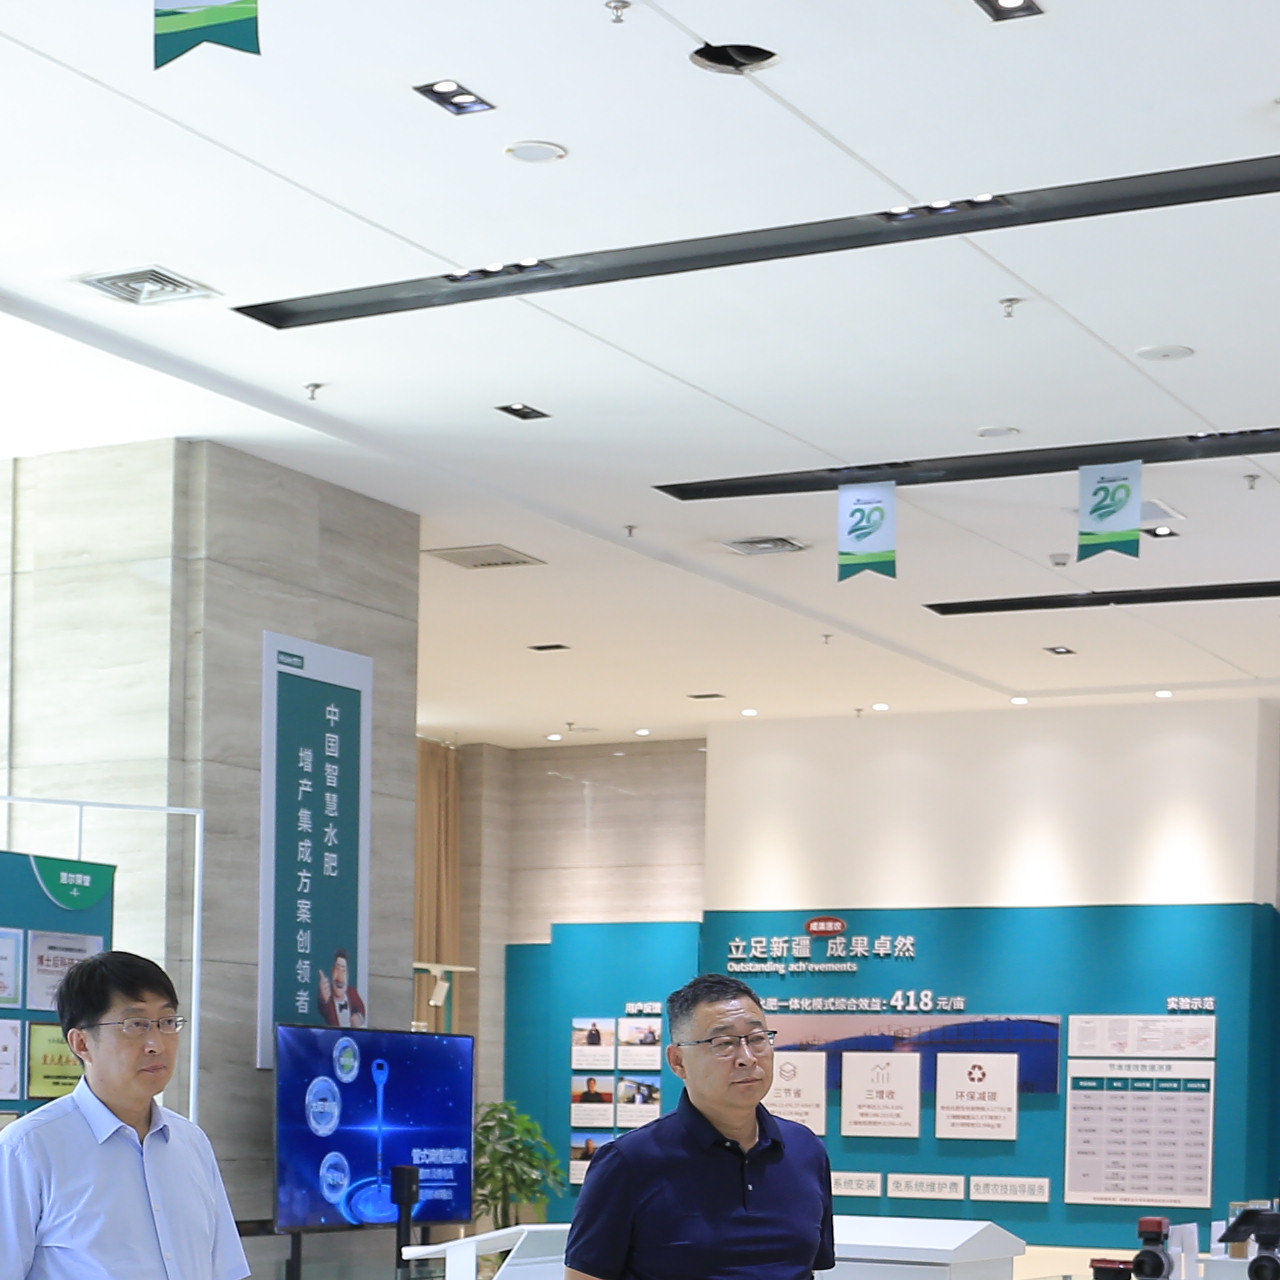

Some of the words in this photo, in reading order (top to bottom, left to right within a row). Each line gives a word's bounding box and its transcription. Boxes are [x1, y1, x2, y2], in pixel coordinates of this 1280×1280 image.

[1090, 483, 1131, 521] 20
[847, 505, 886, 542] 20
[323, 702, 340, 877] 中国智慧水肥
[295, 747, 313, 1015] 增产集成方案创领者
[727, 936, 812, 959] 立足新疆
[826, 935, 916, 958] 成果卓然
[727, 962, 786, 975] Outstanding
[788, 961, 858, 973] achevements
[890, 989, 933, 1011] 418
[936, 996, 966, 1011] 元/亩
[865, 1090, 895, 1100] 三增收
[832, 1178, 876, 1191] 系统安装
[892, 1180, 960, 1194] 免系统维护费
